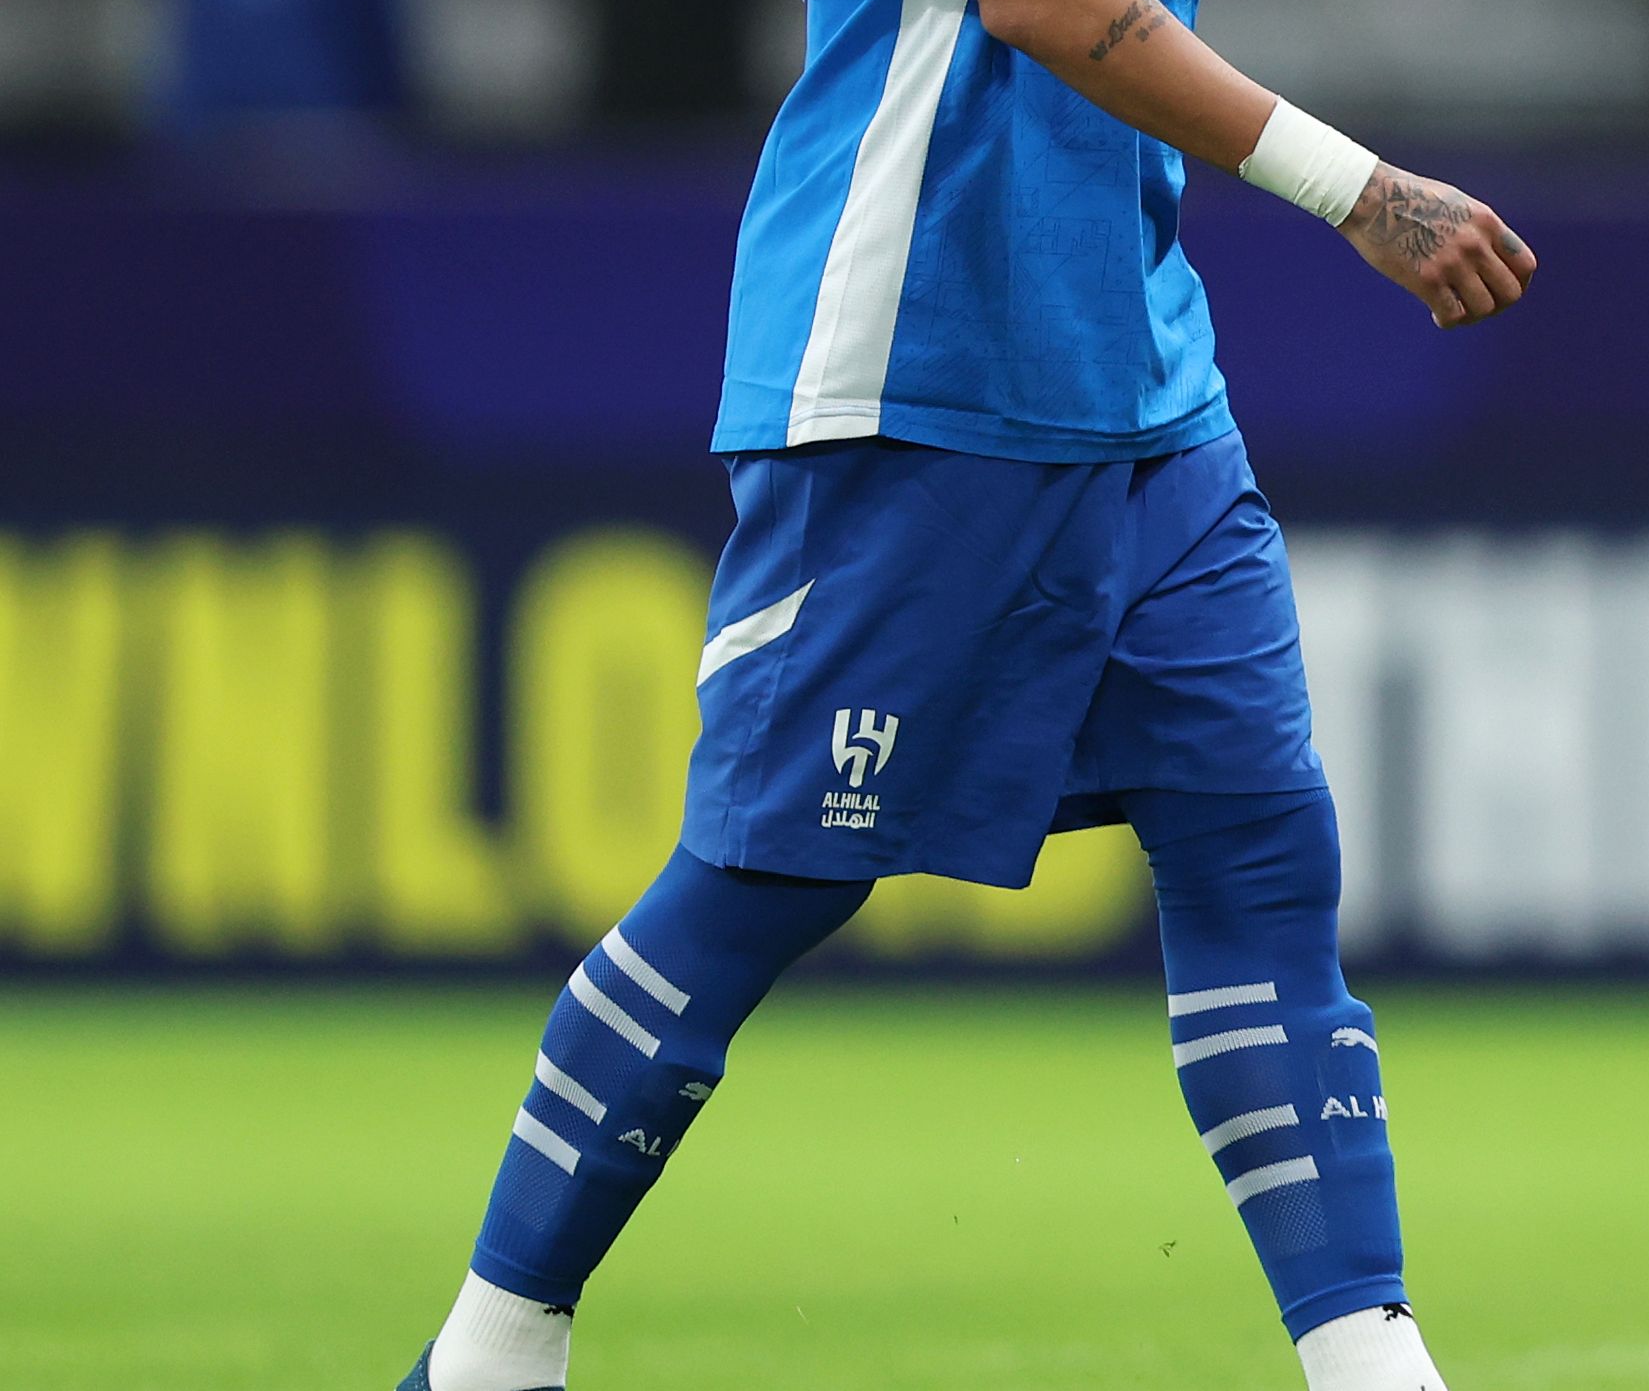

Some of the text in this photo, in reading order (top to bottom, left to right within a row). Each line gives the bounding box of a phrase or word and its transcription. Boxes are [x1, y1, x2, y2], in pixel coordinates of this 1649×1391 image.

[822, 791, 880, 811] ALHILAL
[821, 809, 876, 829] الهلال
[1320, 1095, 1369, 1121] AL
